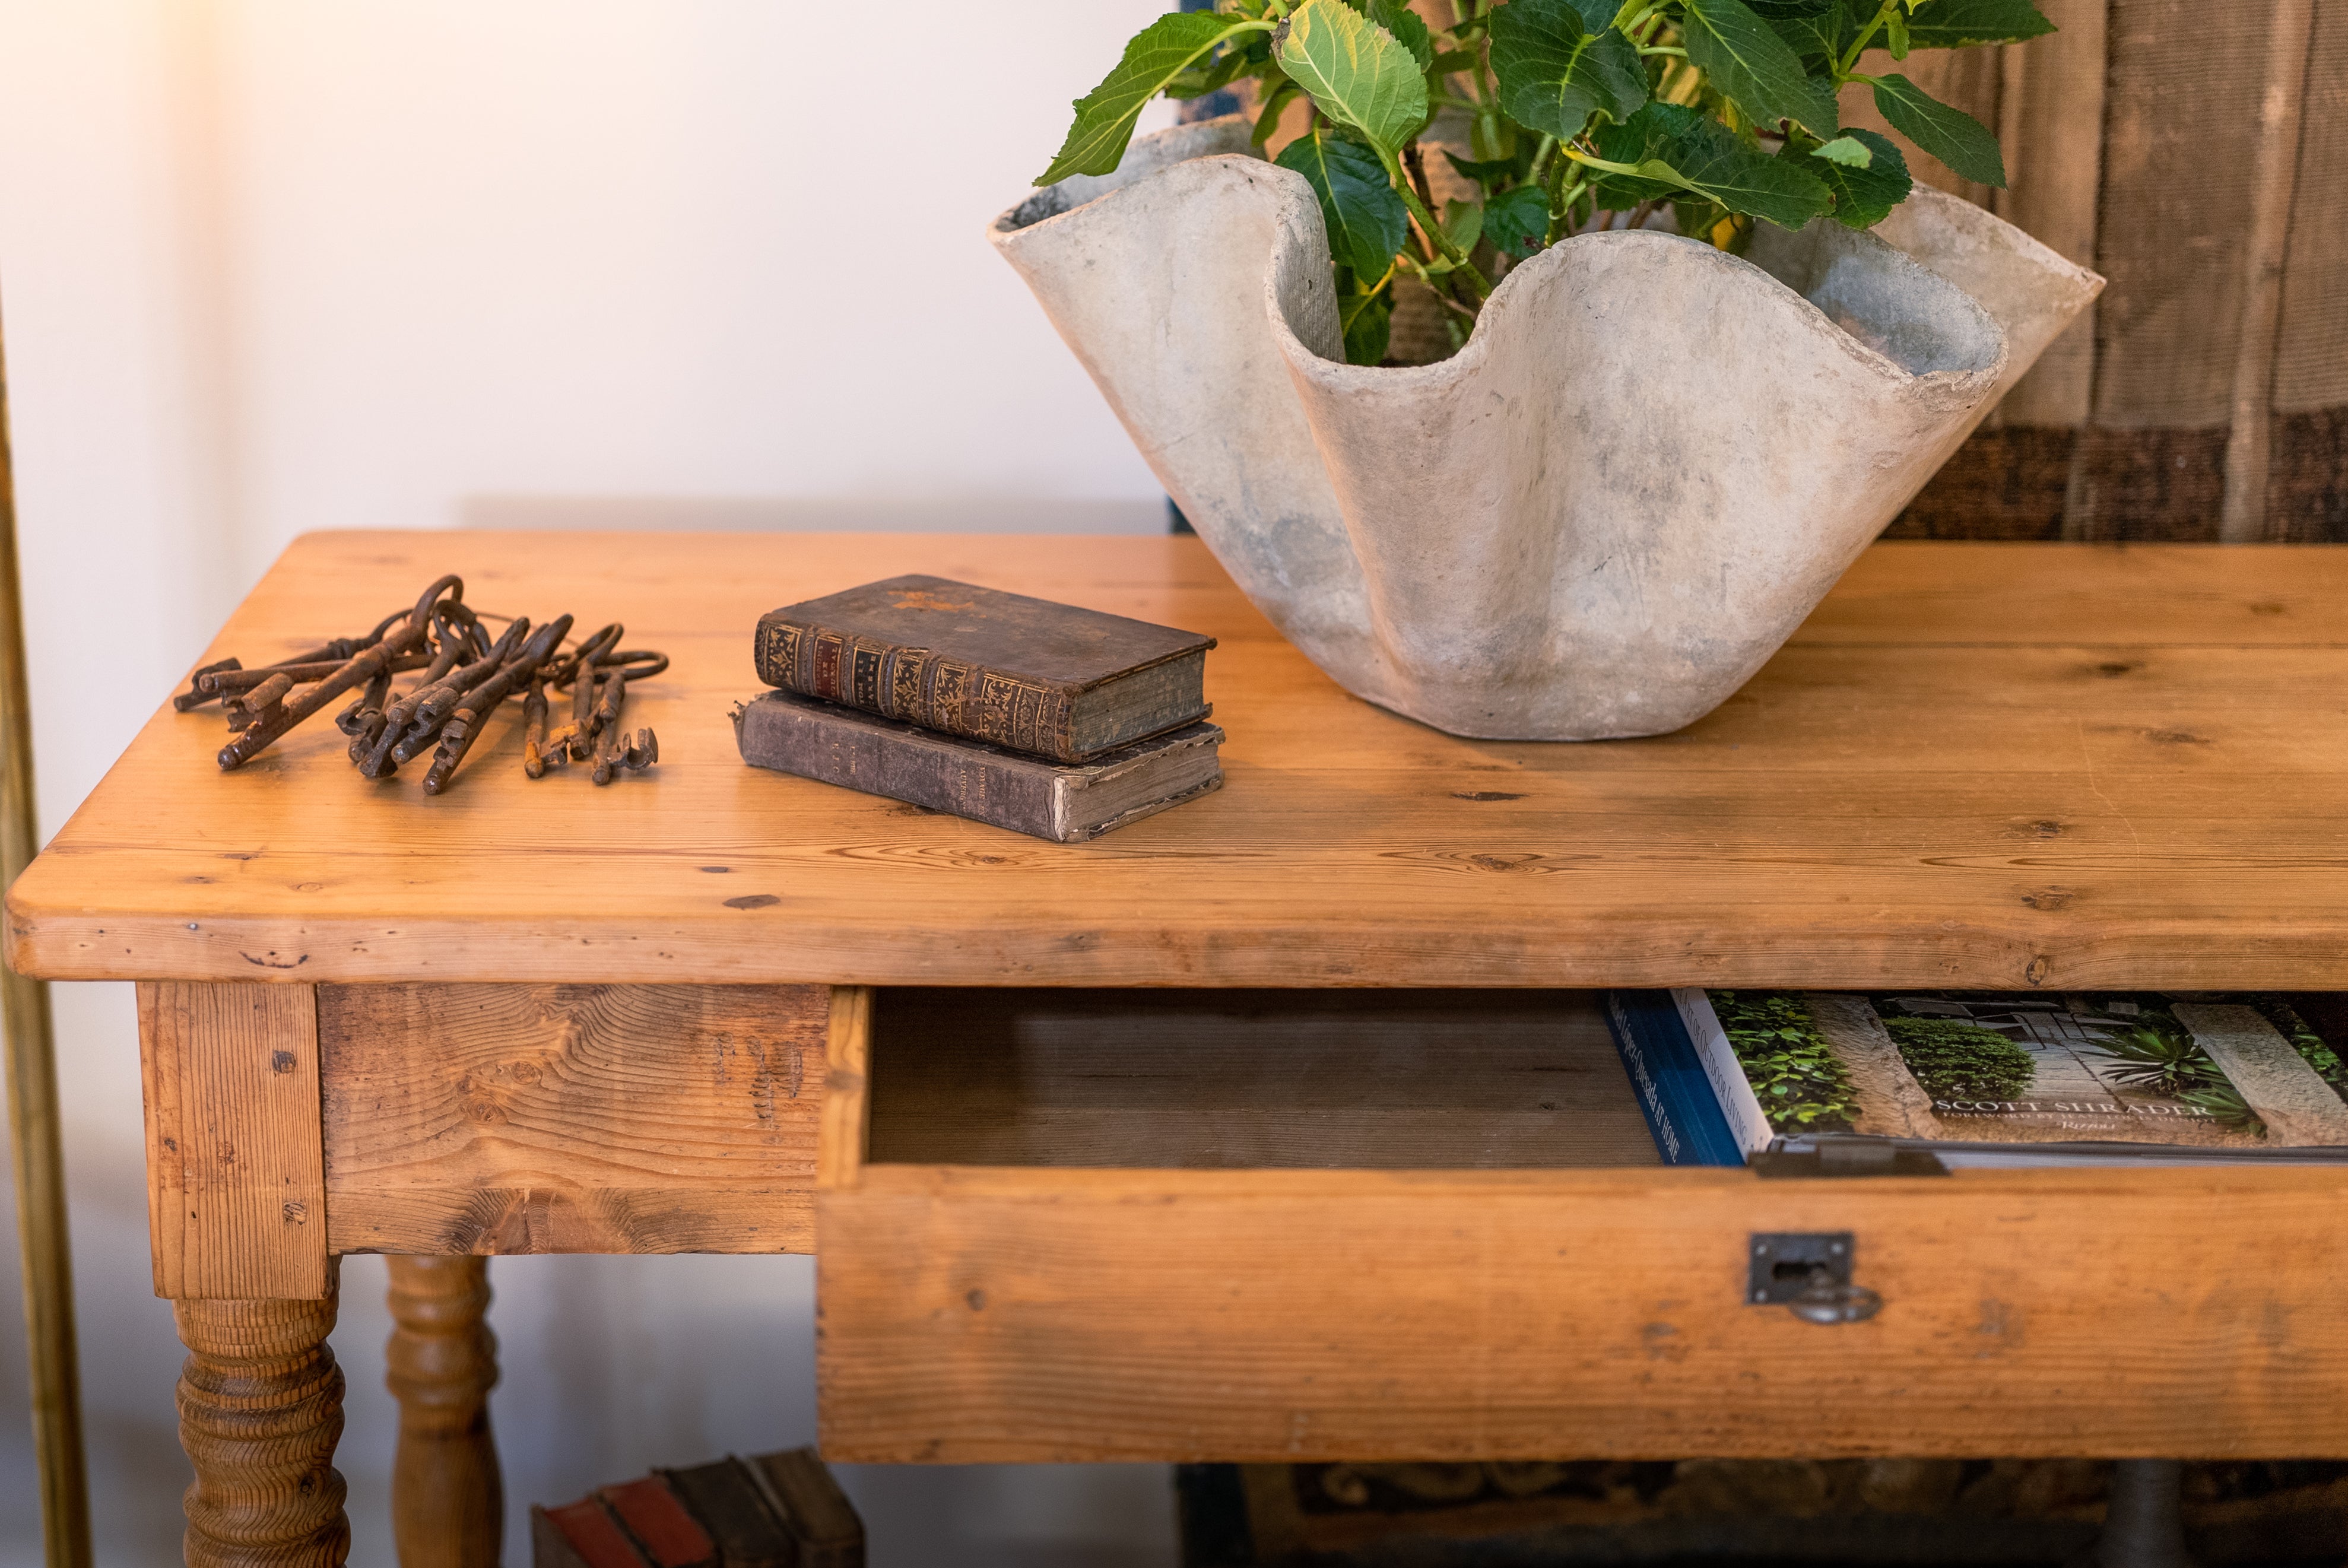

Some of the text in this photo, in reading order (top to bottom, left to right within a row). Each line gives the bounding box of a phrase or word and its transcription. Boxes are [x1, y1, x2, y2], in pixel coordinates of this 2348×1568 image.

[1693, 1018, 1700, 1041] OF
[1700, 1030, 1727, 1102] OUTDOOR
[1726, 1085, 1747, 1145] LIVING
[1936, 1100, 2214, 1116] SCOTT SHRADER
[1655, 1102, 1664, 1126] AT
[1662, 1115, 1680, 1163] HOME
